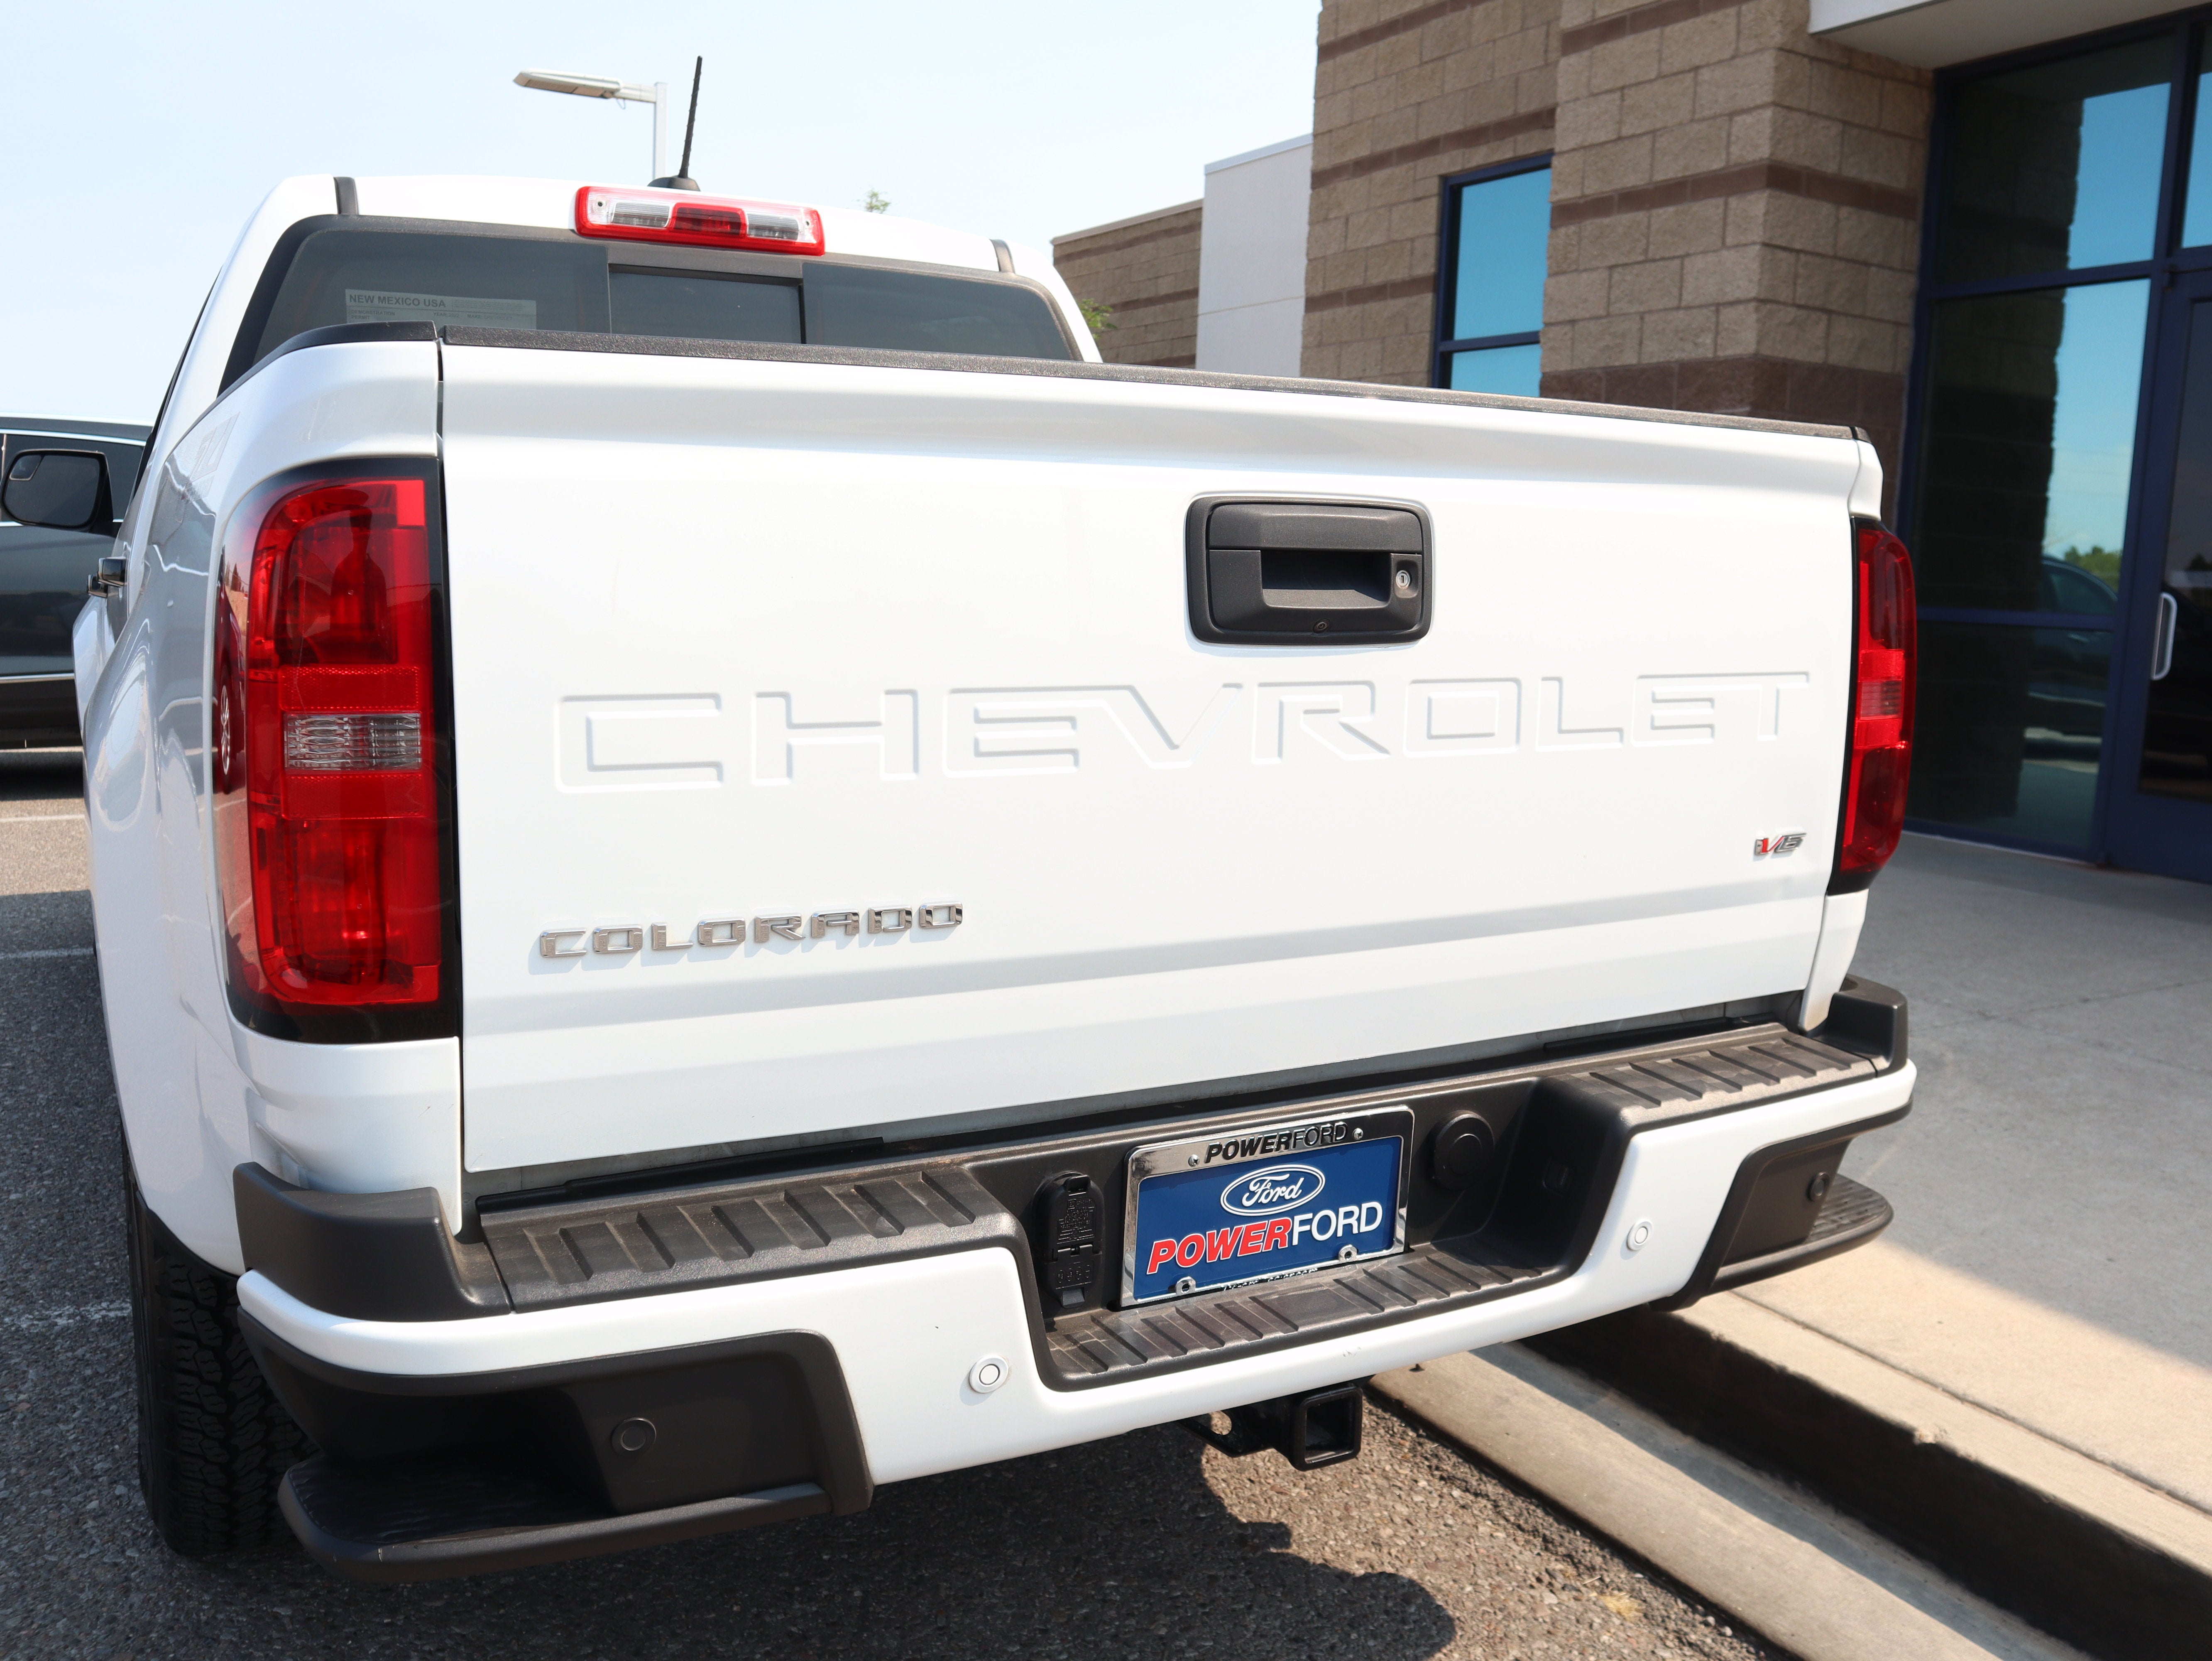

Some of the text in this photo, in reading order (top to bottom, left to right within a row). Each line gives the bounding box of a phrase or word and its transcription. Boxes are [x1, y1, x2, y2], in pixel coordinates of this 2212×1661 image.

[350, 294, 374, 304] NEW
[378, 296, 420, 306] MEXICO
[424, 299, 446, 307] USA
[555, 671, 1810, 794] CHEVROLET
[1755, 833, 1807, 855] V6
[540, 901, 964, 958] COLORADO
[1205, 1121, 1348, 1163] POWERFORD
[1241, 1173, 1304, 1208] Ford
[1146, 1201, 1383, 1275] POWERFORD
